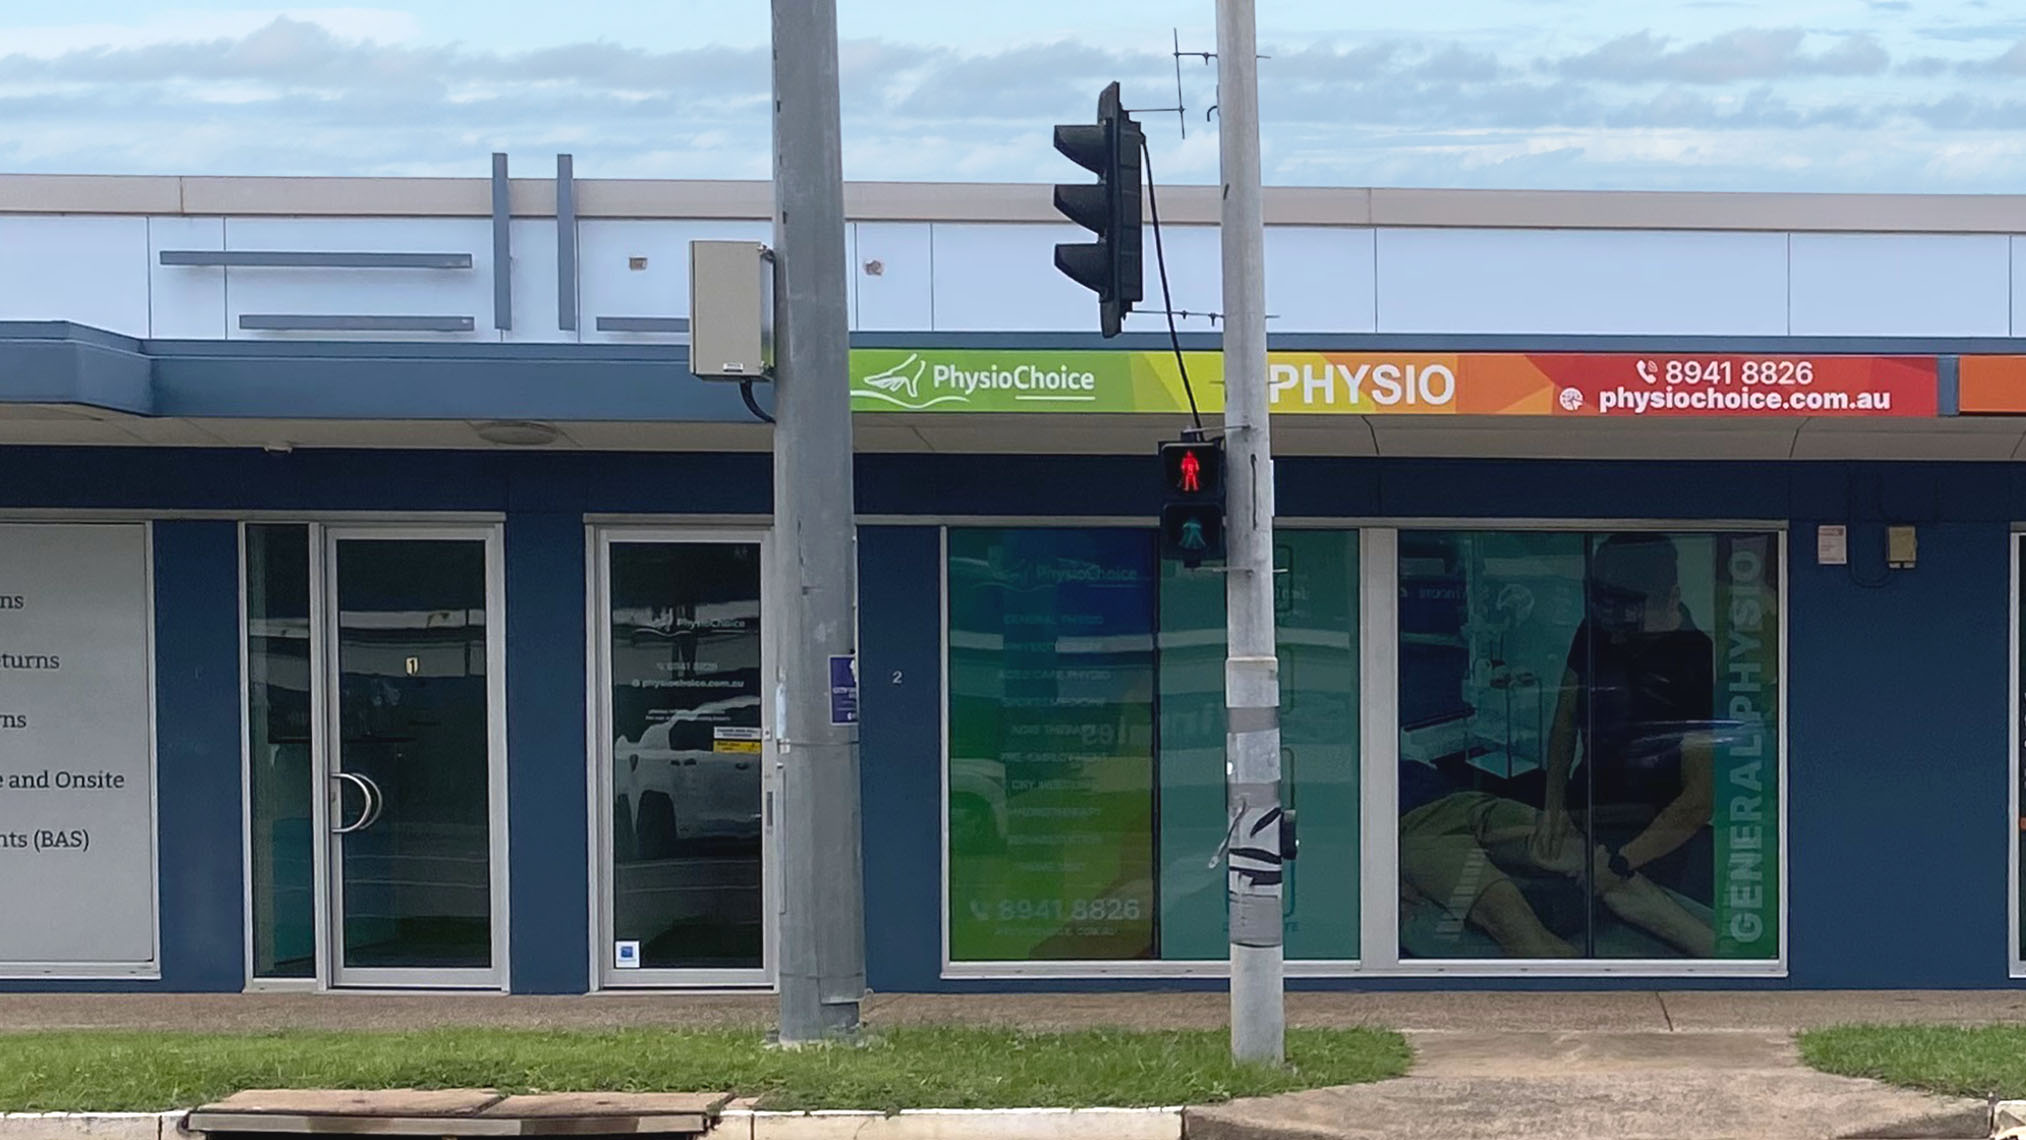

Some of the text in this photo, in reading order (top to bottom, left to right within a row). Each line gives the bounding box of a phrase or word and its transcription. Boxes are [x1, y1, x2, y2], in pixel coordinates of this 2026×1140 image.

[932, 364, 1096, 397] PhysioChoice
[1268, 363, 1456, 405] PHYSIO
[1665, 359, 1813, 386] 8941 8826
[1599, 386, 1891, 414] physiochoice.com.au
[0, 653, 60, 669] turns
[892, 670, 903, 685] 2
[1729, 549, 1764, 943] GENERAL PHYSIO
[9, 771, 50, 789] and
[55, 771, 125, 789] Onsite
[34, 830, 90, 852] (BAS)
[998, 899, 1141, 921] 8941 8826
